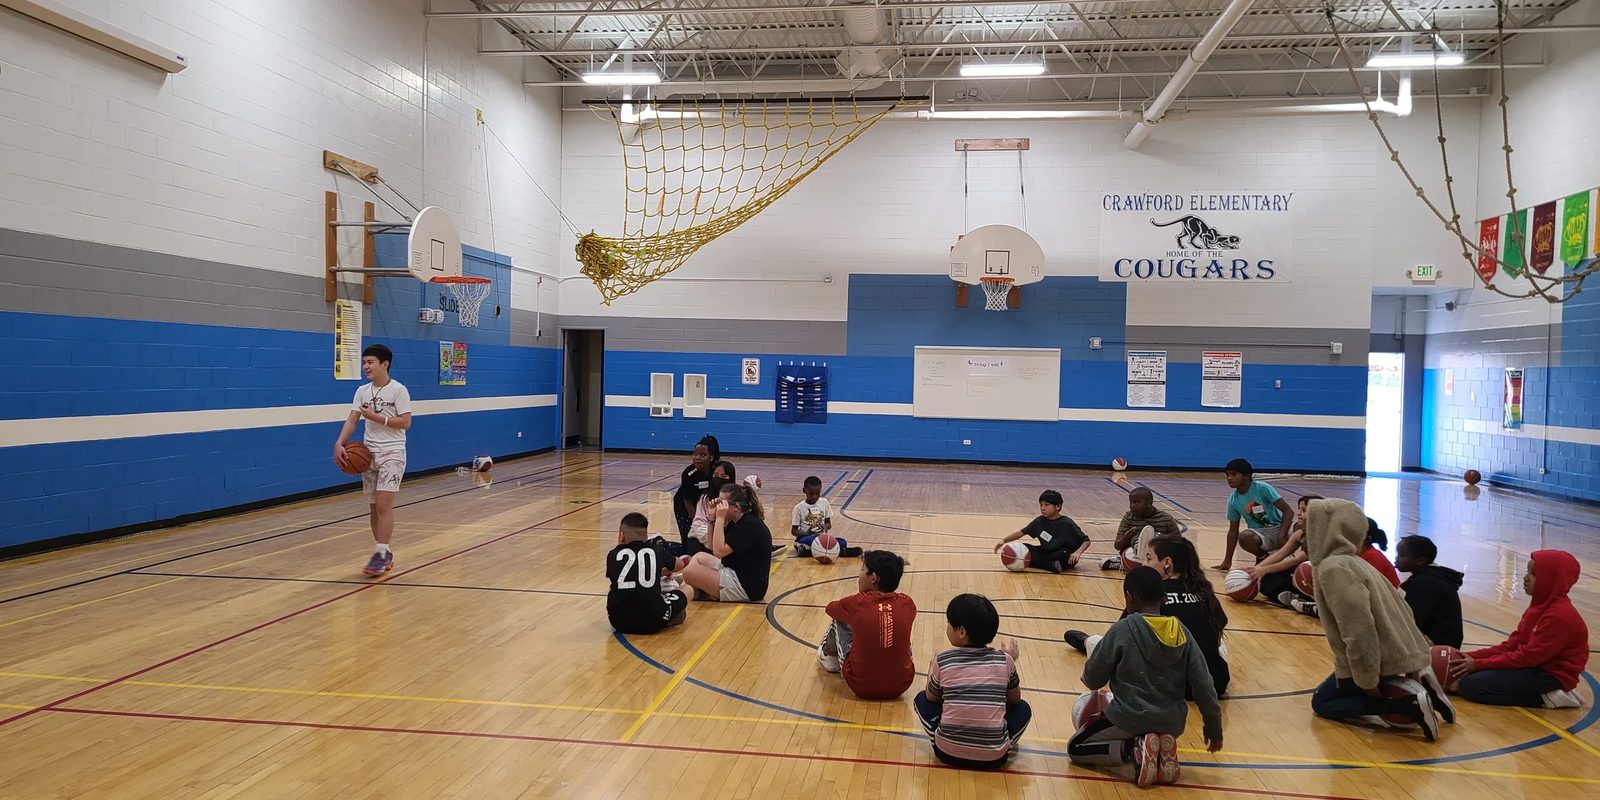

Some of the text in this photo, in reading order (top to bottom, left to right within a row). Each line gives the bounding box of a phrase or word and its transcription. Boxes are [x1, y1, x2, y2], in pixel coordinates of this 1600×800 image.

[1102, 193, 1293, 211] CRAWFORD ELEMENTARY
[1114, 258, 1276, 280] COUGARS
[1417, 265, 1433, 276] EXIT
[616, 547, 657, 590] 20
